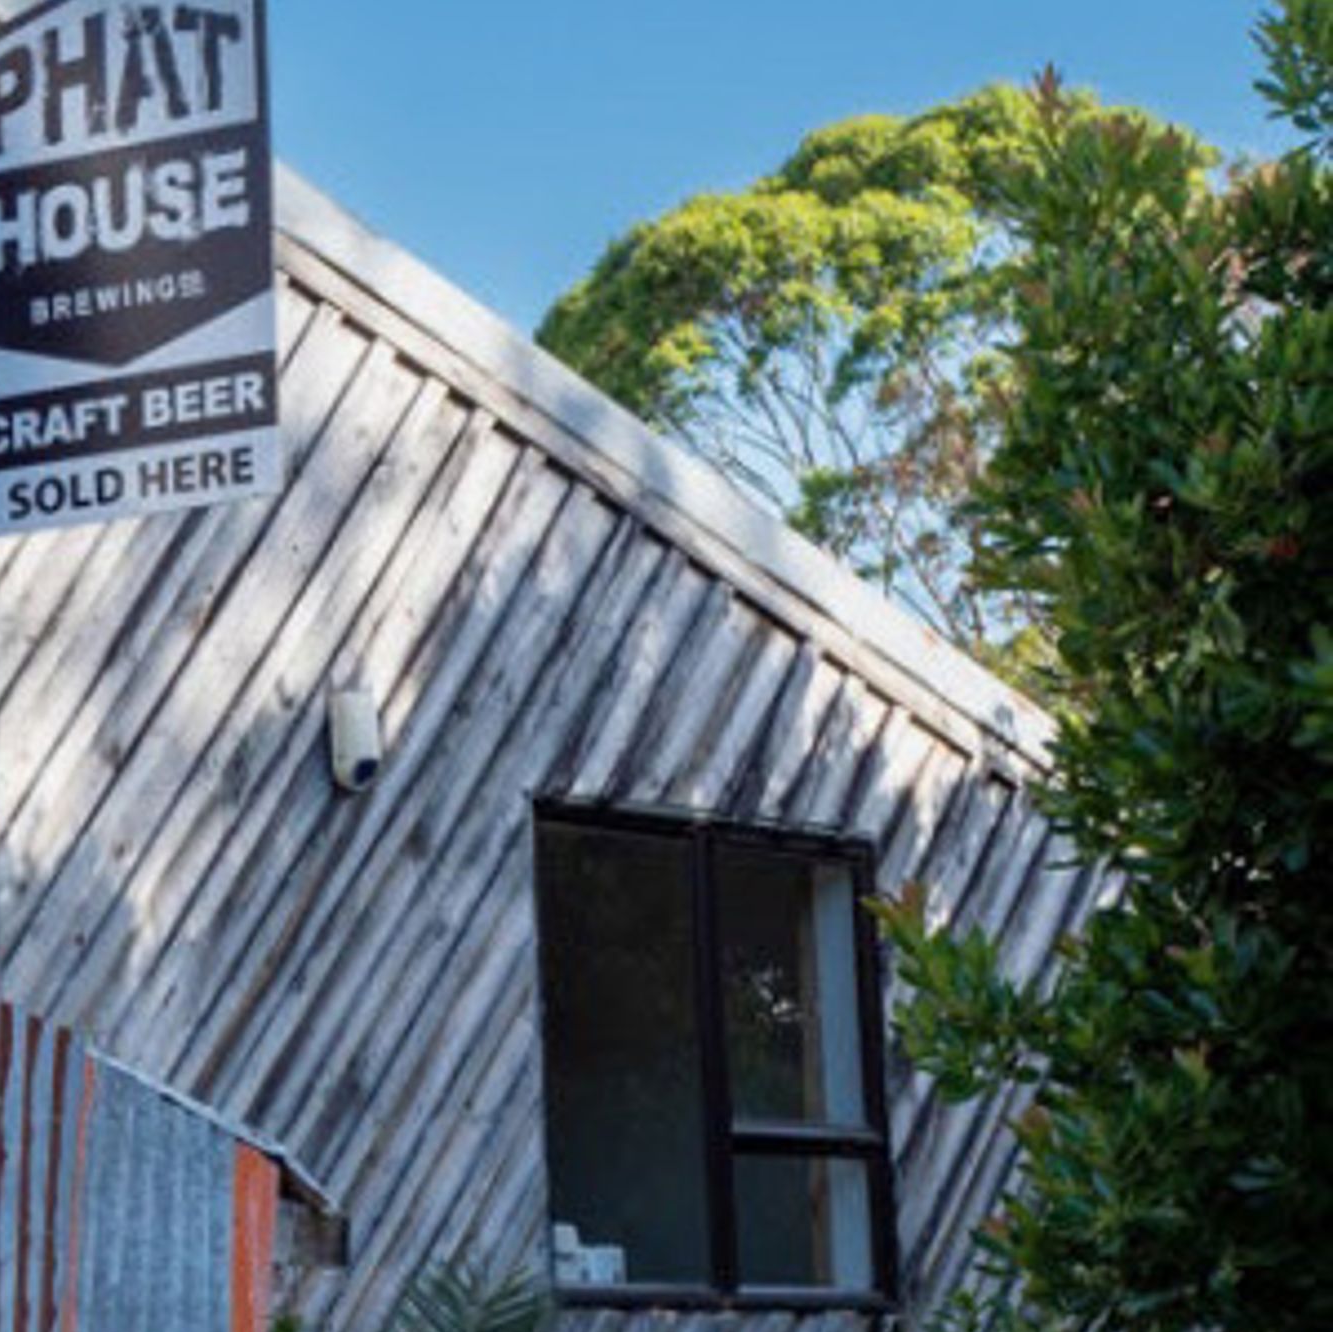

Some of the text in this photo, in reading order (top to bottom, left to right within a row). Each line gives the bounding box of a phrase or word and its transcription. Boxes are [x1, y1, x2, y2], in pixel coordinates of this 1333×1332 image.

[30, 274, 175, 326] BREWING
[142, 371, 266, 430] BEER
[7, 446, 255, 522] SOLD HERE
